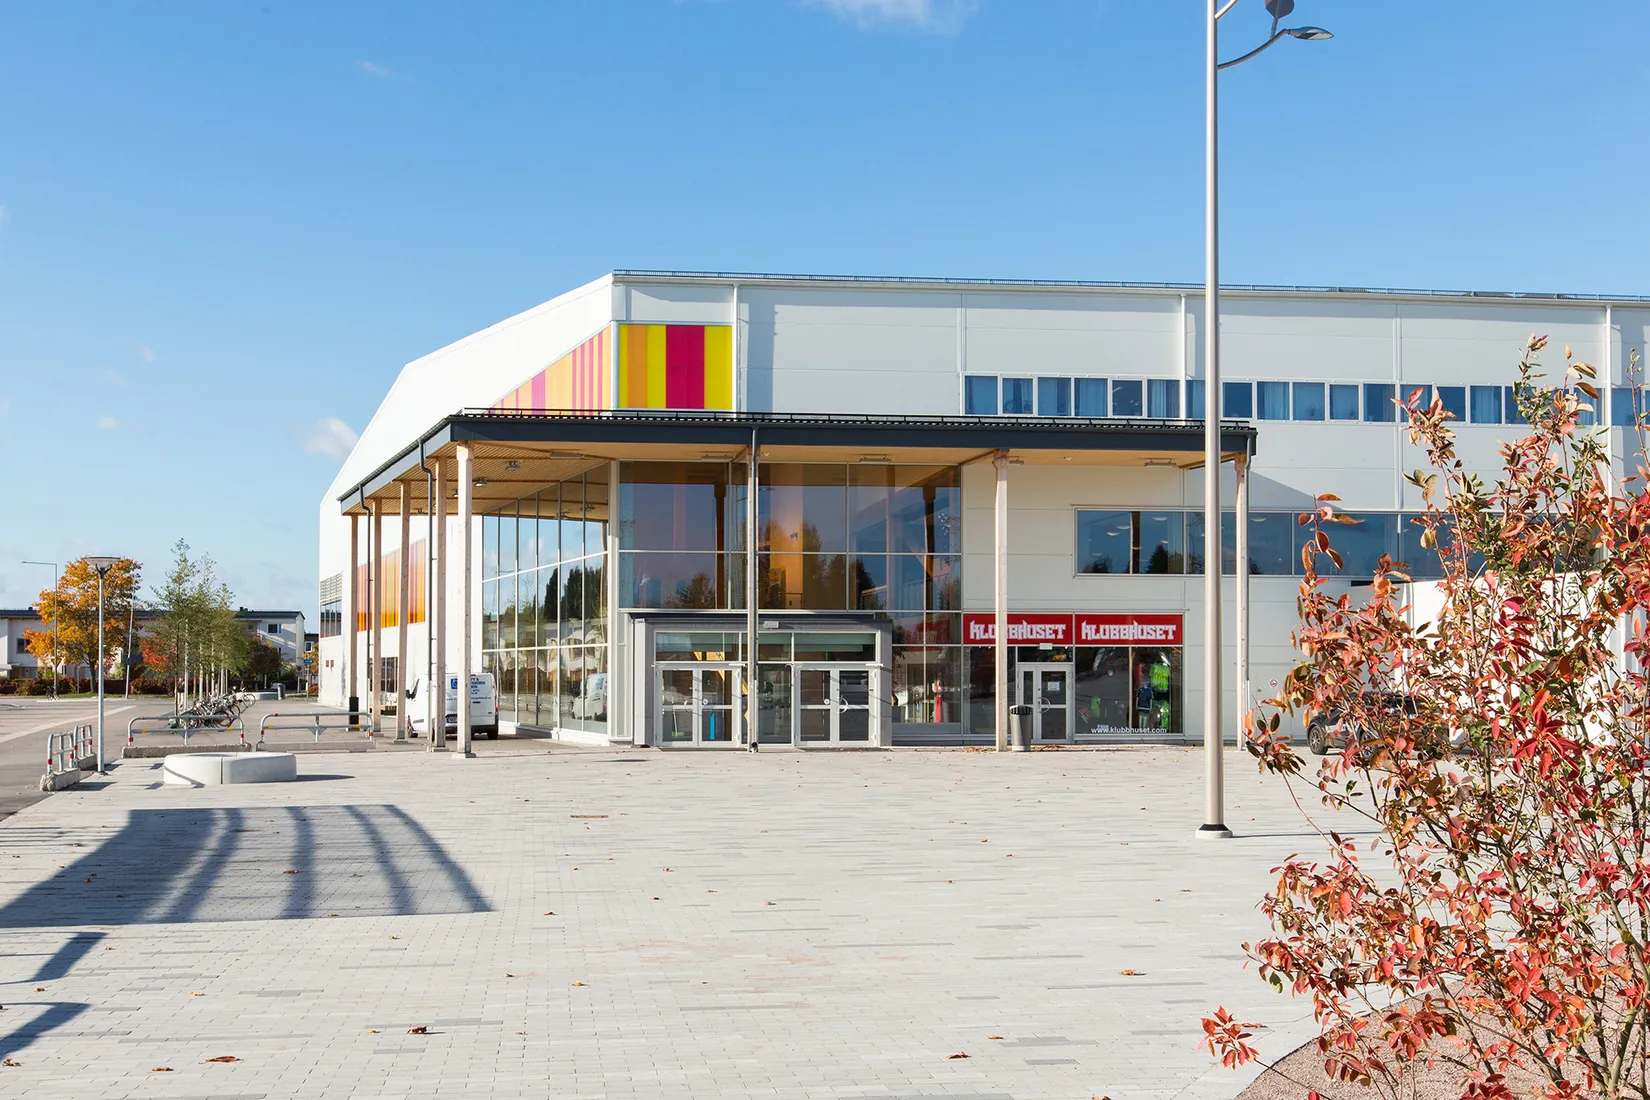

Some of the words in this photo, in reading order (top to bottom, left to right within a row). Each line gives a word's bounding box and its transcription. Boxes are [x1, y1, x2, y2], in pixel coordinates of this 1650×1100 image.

[969, 620, 1067, 640] KLUBHUSET
[1081, 620, 1177, 640] KLUBBHUSET
[1091, 726, 1167, 734] www.klubbhuset.com
